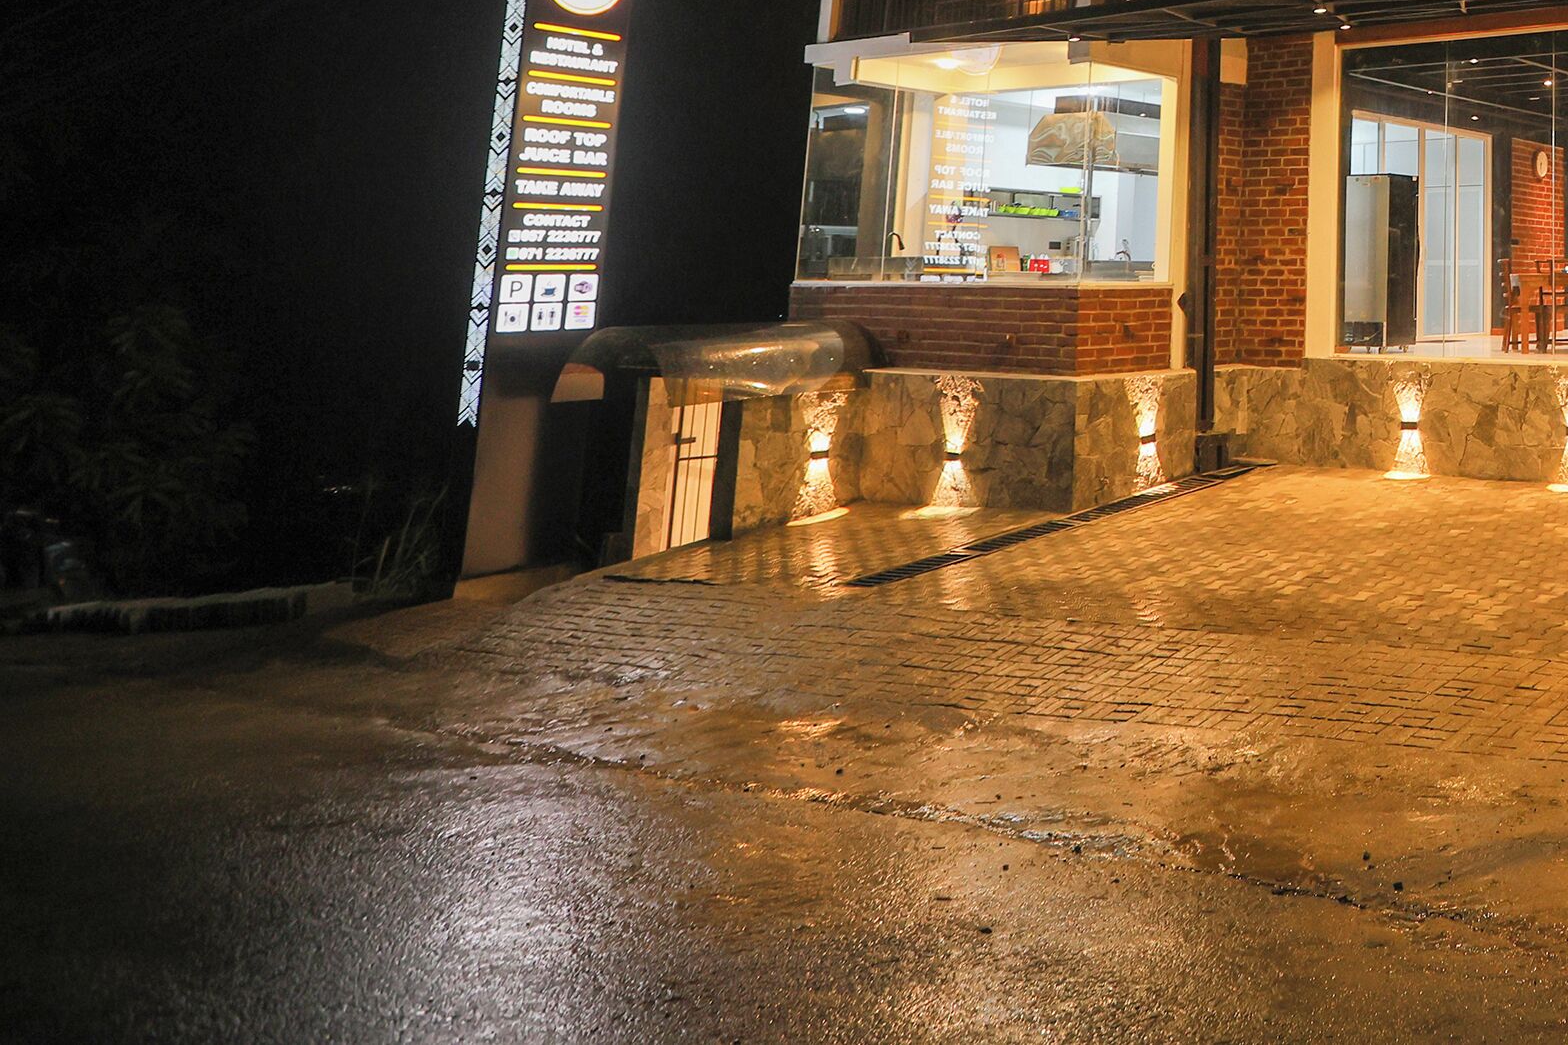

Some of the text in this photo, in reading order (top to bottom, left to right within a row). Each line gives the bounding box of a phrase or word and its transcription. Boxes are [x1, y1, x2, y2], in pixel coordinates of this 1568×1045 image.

[546, 36, 604, 56] HOTEL &
[530, 50, 618, 74] RESTAURANT
[526, 82, 614, 102] COMFORTABLE
[542, 100, 596, 116] ROOMS
[524, 128, 606, 146] ROOF TOP
[520, 146, 608, 166] JUICE BAR
[516, 180, 604, 198] TAKE AWAY
[522, 214, 590, 228] CONTACT
